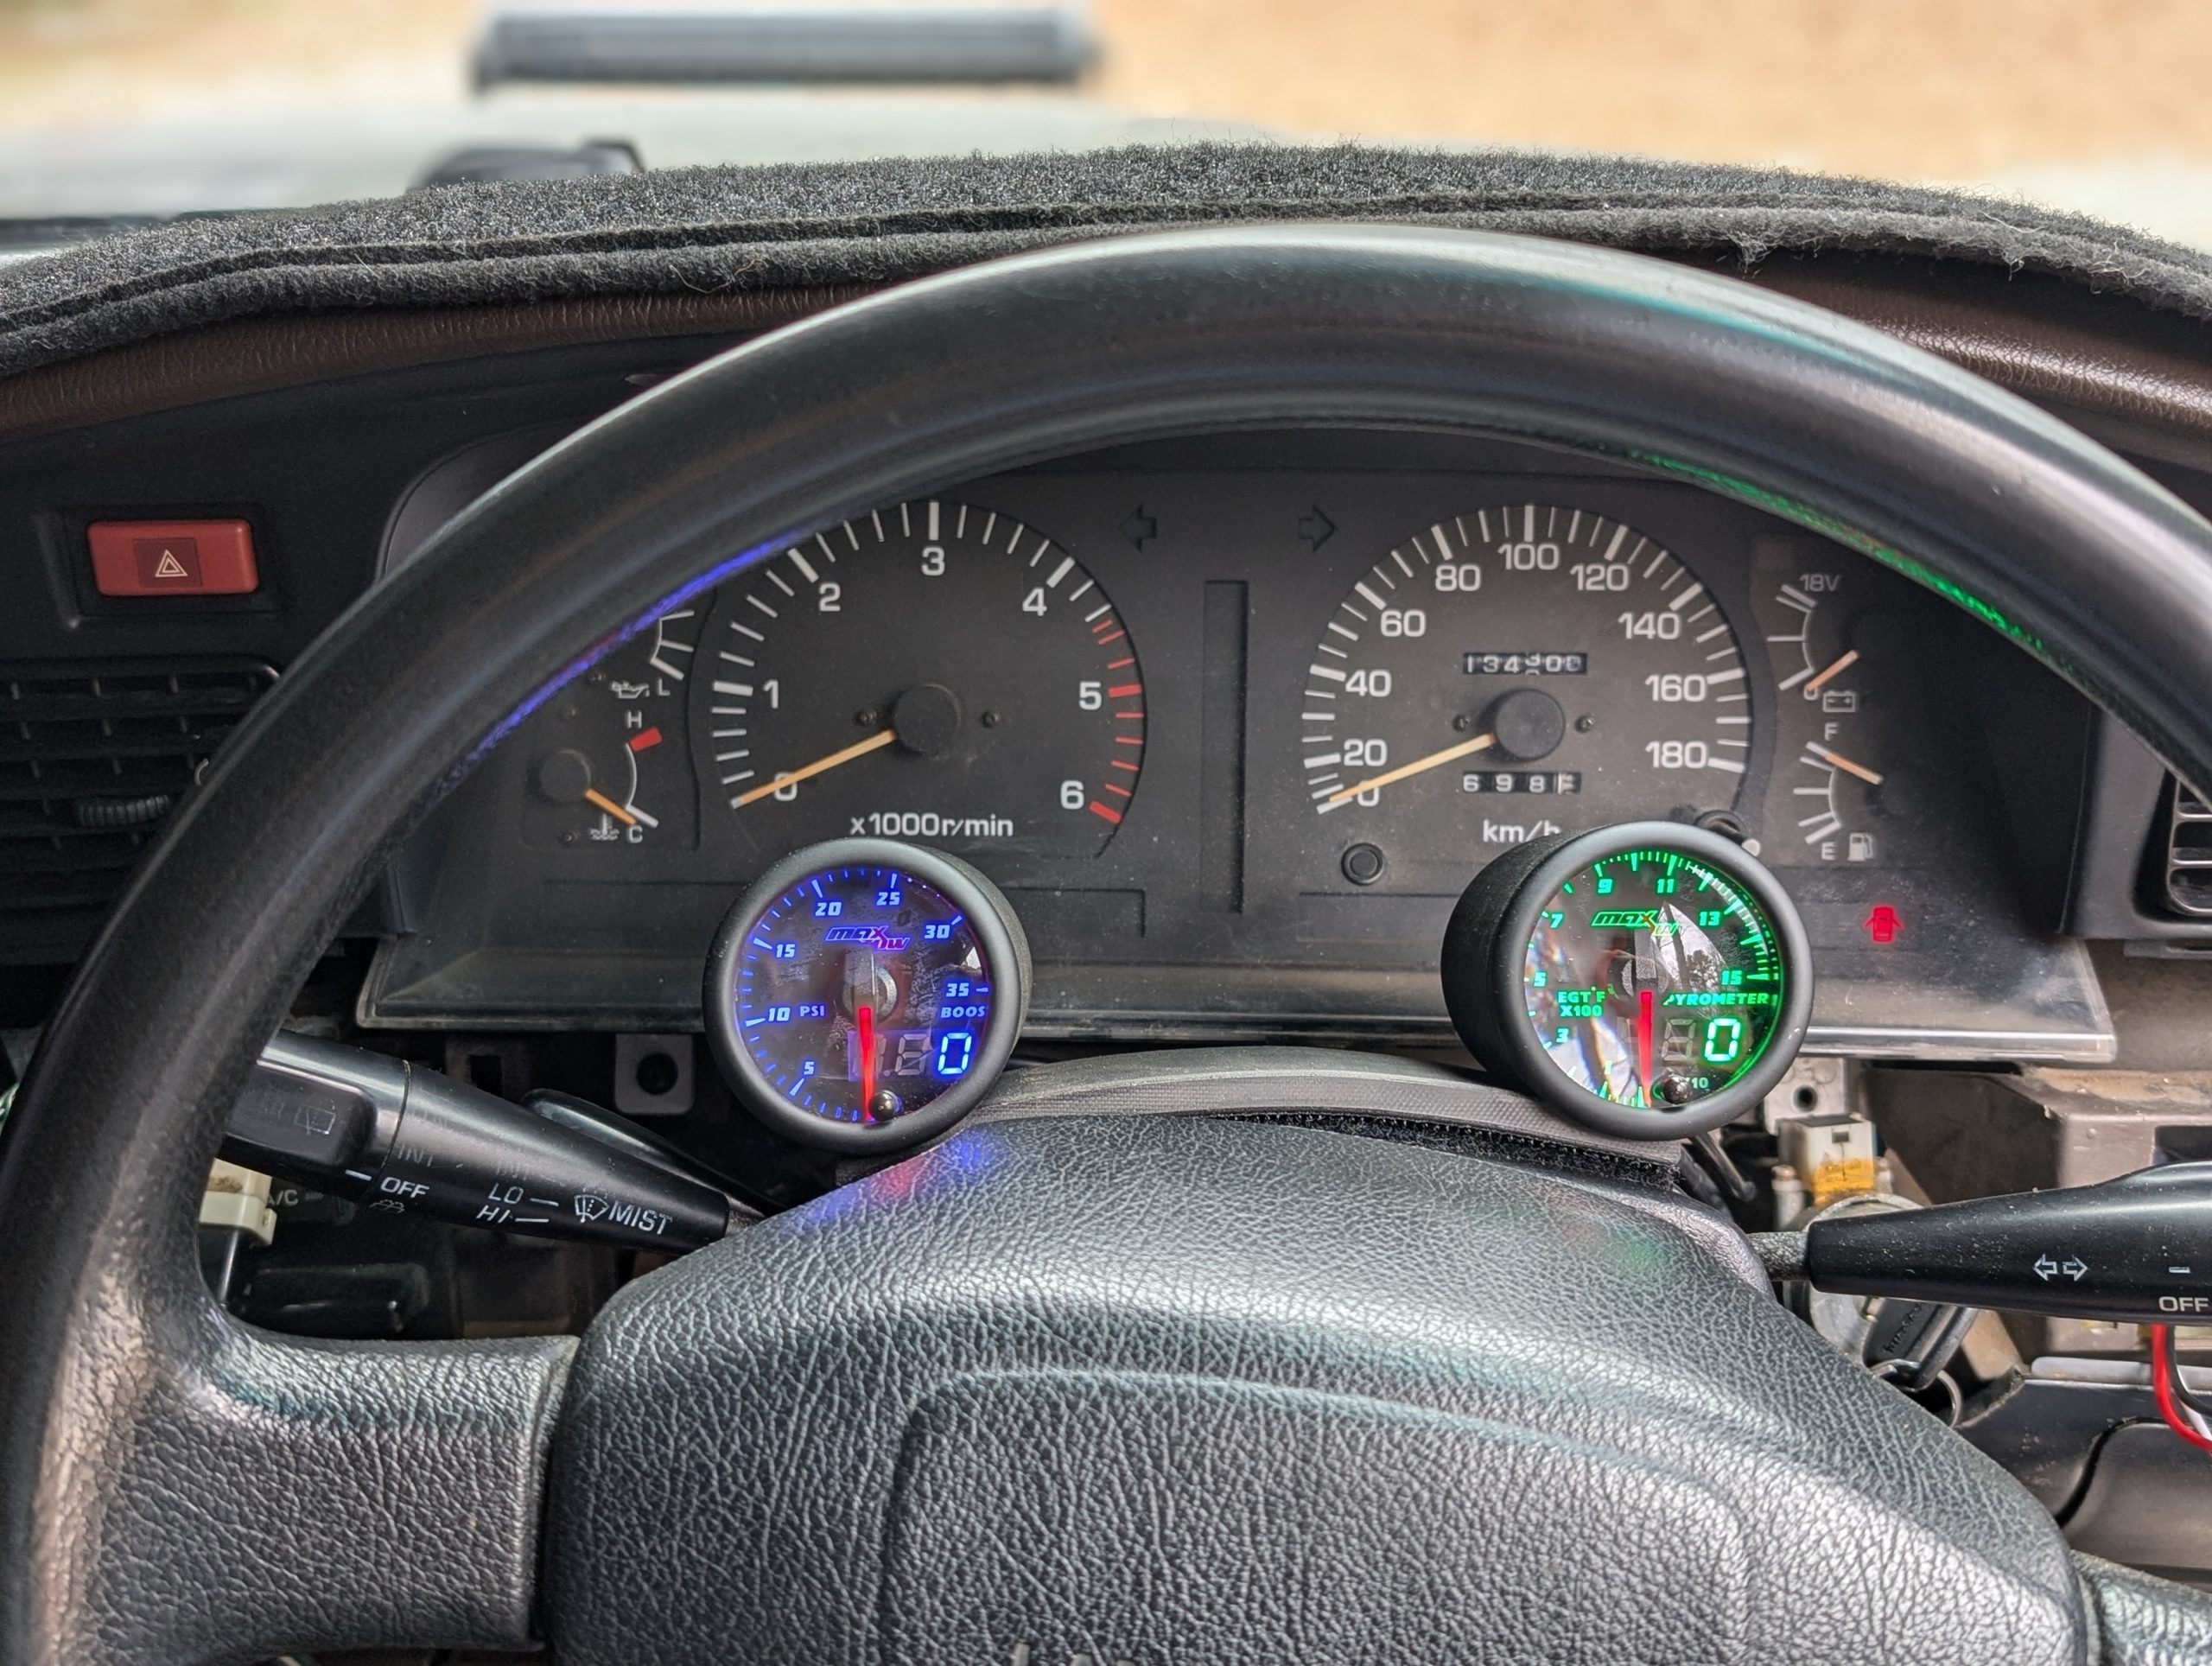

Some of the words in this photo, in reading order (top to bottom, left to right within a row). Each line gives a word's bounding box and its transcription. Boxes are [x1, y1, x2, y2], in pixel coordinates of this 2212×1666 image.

[921, 549, 944, 575] 3
[1498, 544, 1560, 570] 100
[1435, 565, 1480, 591] 80
[1570, 564, 1629, 591] 120
[1800, 574, 1840, 592] 18V
[819, 583, 841, 612] 2
[1022, 588, 1046, 616] 4
[1381, 610, 1425, 637] 60
[1618, 613, 1680, 639] 140
[1344, 671, 1391, 696] 40
[1645, 675, 1707, 701] 160
[764, 680, 779, 709] 1
[1079, 683, 1102, 710] 5
[627, 711, 642, 728] H
[1825, 722, 1839, 741] F
[1344, 740, 1387, 766] 20
[1646, 741, 1707, 768] 180
[774, 773, 798, 801] 0
[1061, 782, 1084, 810] 6
[628, 826, 643, 843] C
[1822, 843, 1837, 860] E
[1598, 879, 1612, 893] 9
[1657, 879, 1675, 893] 11
[876, 892, 900, 906] 25
[816, 902, 842, 916] 20
[1699, 912, 1720, 925] 13
[925, 925, 950, 939] 30
[776, 944, 795, 957] 15
[1534, 972, 1547, 986] 5
[1721, 970, 1742, 984] 15
[945, 982, 969, 997] 35
[1558, 991, 1591, 1002] EGT
[768, 1008, 791, 1021] 10
[799, 1006, 824, 1016] PSI
[940, 1006, 988, 1018] BOOS
[1556, 1028, 1569, 1042] 3
[1704, 1018, 1741, 1061] 0
[938, 1033, 972, 1074] 0
[804, 1061, 815, 1075] 5
[380, 1176, 430, 1199] OFF
[488, 1183, 524, 1205] LO
[476, 1205, 512, 1224] HI
[607, 1199, 673, 1235] MIST
[2158, 1295, 2209, 1313] OFF
